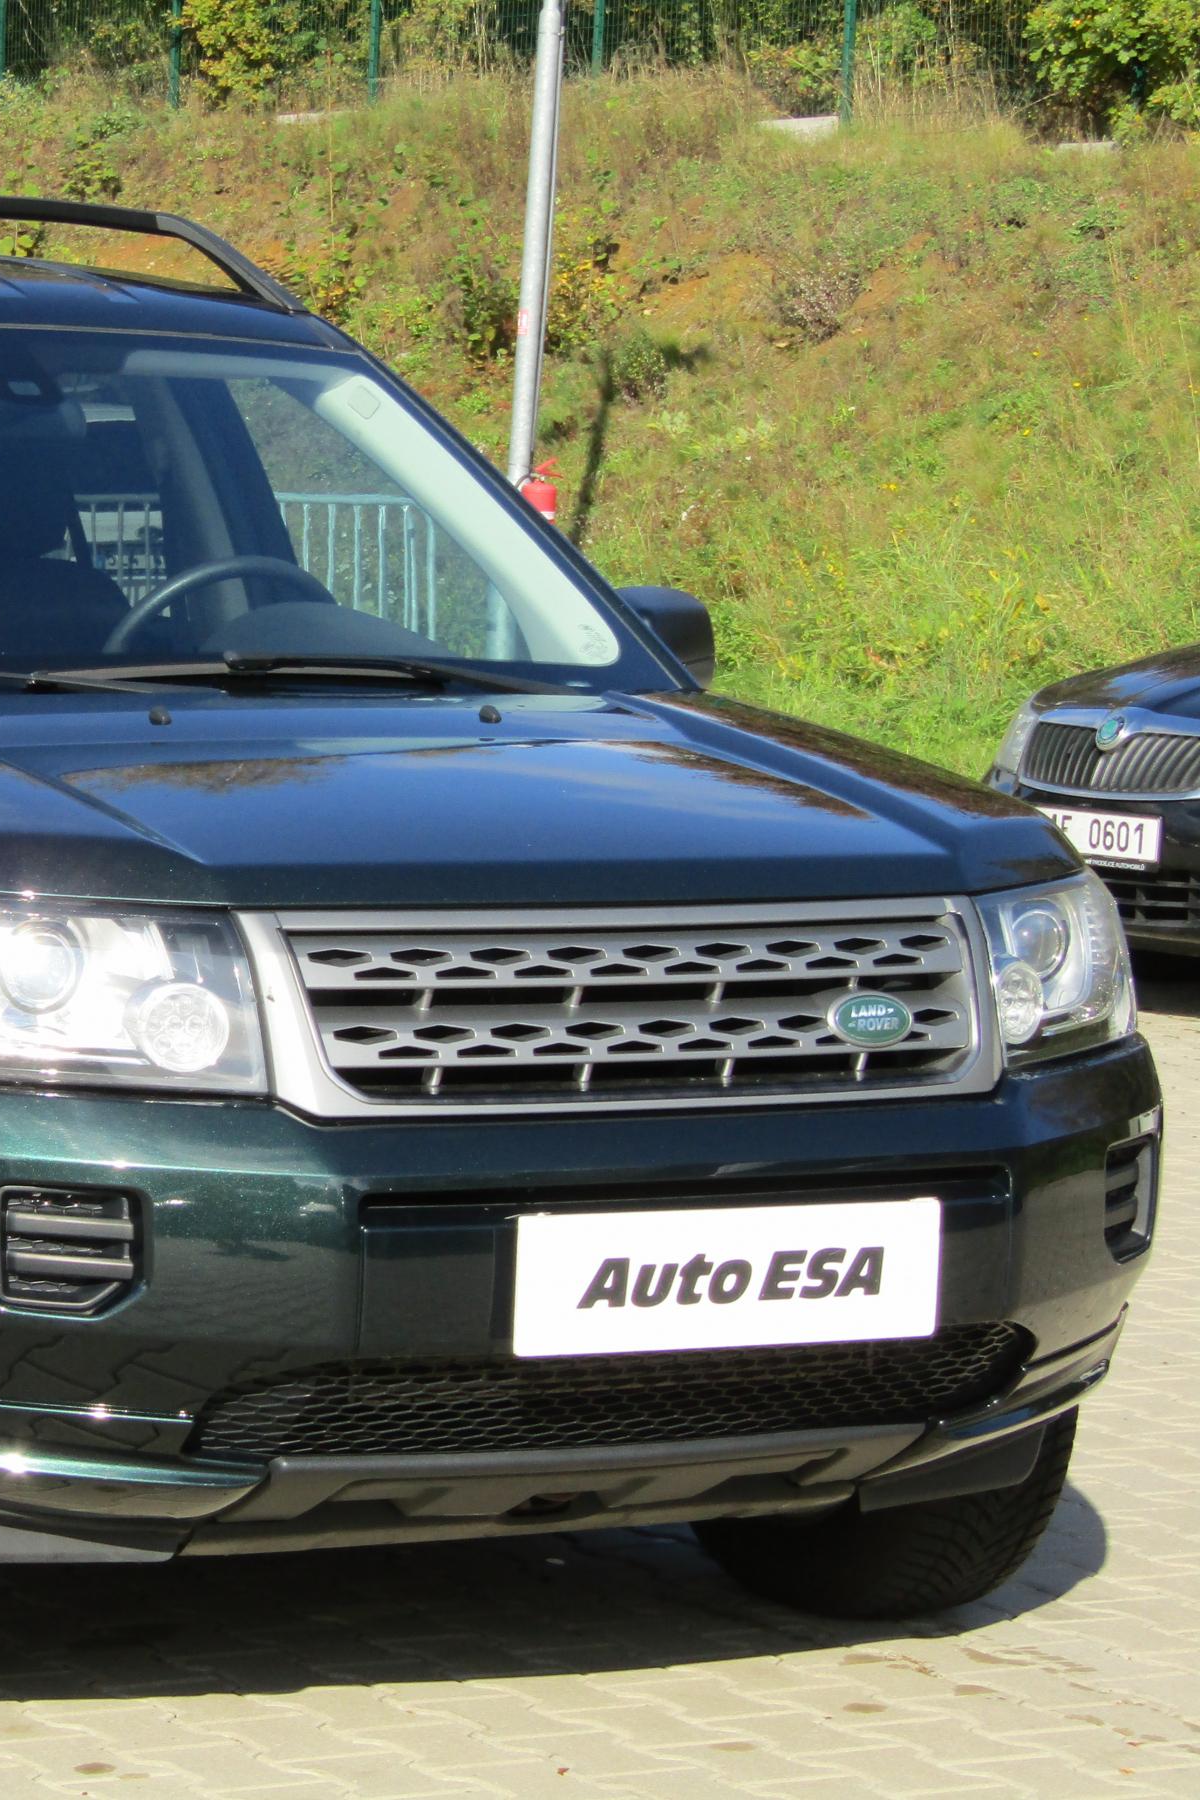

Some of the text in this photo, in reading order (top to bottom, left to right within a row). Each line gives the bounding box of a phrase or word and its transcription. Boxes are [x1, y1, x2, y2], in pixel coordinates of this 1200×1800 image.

[1089, 818, 1145, 855] 0601
[851, 1004, 886, 1018] LAND
[857, 1017, 899, 1031] ROVER
[576, 1247, 885, 1309] Auto ESA
